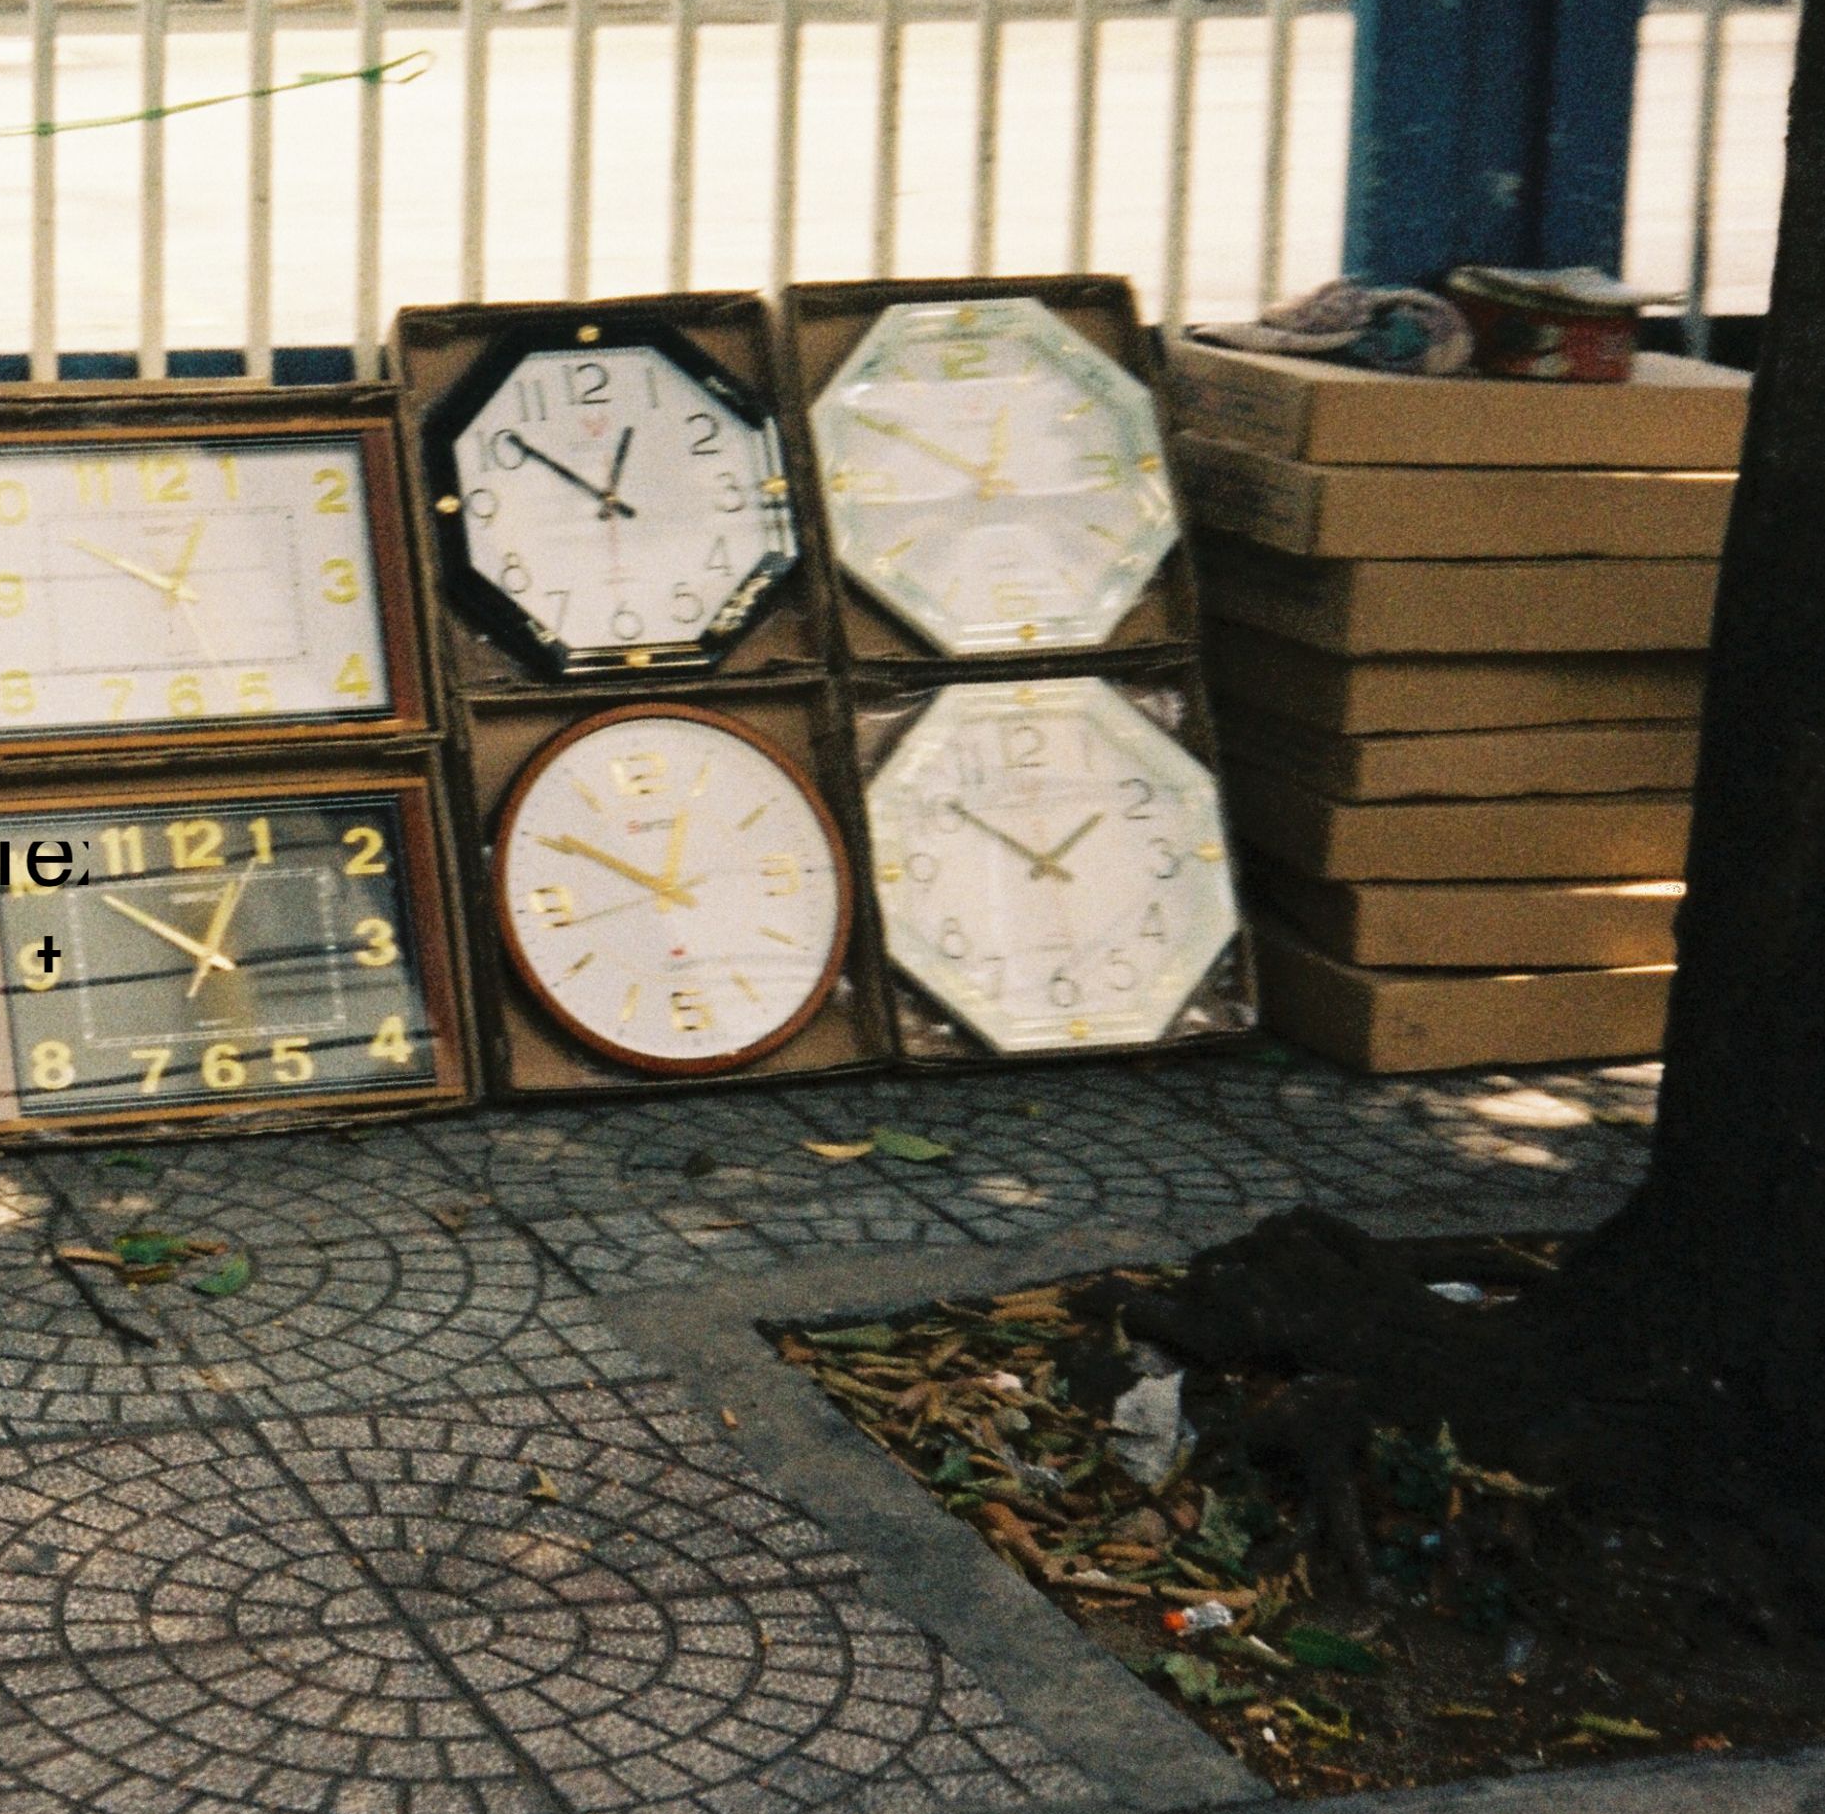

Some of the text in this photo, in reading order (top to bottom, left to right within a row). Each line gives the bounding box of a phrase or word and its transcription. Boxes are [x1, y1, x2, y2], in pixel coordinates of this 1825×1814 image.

[941, 342, 989, 380] 12
[515, 380, 547, 423] 11
[562, 363, 611, 405] 12
[646, 367, 660, 409] 1
[477, 429, 527, 473] 10
[685, 412, 721, 457] 2
[74, 460, 114, 507] 11
[137, 455, 192, 504] 12
[218, 452, 241, 501] 1
[311, 467, 351, 514] 2
[715, 471, 746, 513] 3
[501, 551, 532, 594] 8
[704, 535, 733, 578] 4
[319, 557, 361, 605] 3
[673, 581, 704, 624] 5
[545, 589, 570, 632] 7
[611, 598, 644, 641] 6
[166, 674, 206, 717] 6
[235, 672, 275, 715] 5
[333, 653, 372, 700] 4
[99, 677, 136, 723] 7
[996, 726, 1047, 769] 12
[608, 752, 672, 796] 12
[1118, 778, 1156, 821] 2
[99, 825, 147, 875] 11
[163, 819, 226, 869] 12
[248, 817, 274, 865] 1
[340, 826, 387, 876] 2
[1148, 837, 1178, 880] 3
[759, 852, 800, 897] 3
[530, 886, 574, 930] 9
[352, 918, 400, 967] 3
[939, 916, 969, 960] 8
[1051, 967, 1082, 1008] 6
[1109, 948, 1136, 991] 5
[670, 989, 714, 1032] 6
[271, 1036, 314, 1085] 5
[369, 1014, 413, 1063] 4
[32, 1040, 75, 1090] 8
[131, 1048, 171, 1094] 7
[201, 1044, 246, 1090] 6
